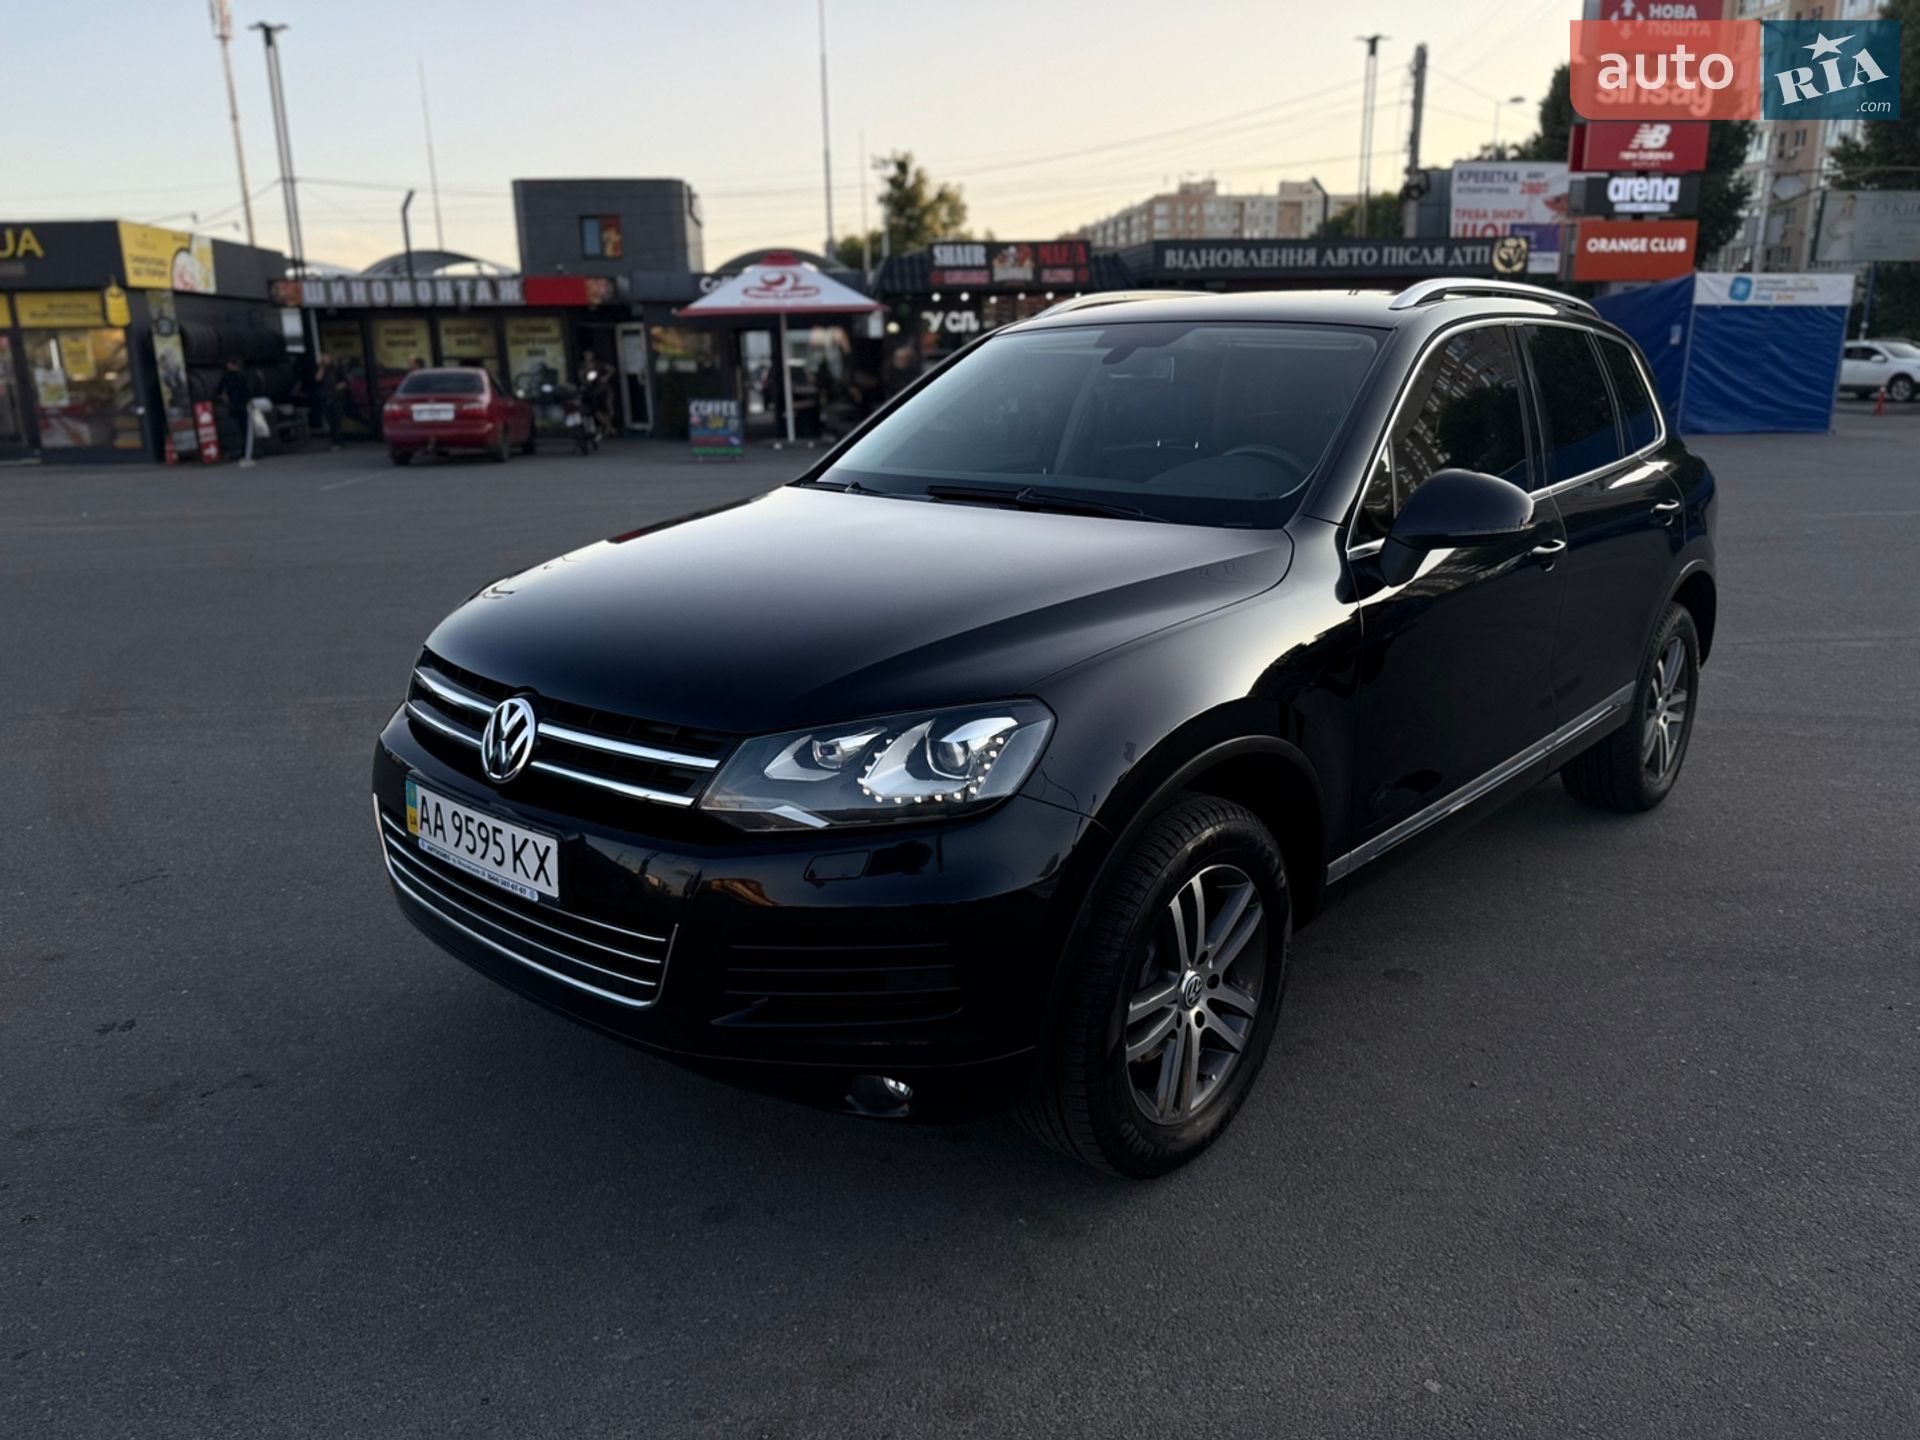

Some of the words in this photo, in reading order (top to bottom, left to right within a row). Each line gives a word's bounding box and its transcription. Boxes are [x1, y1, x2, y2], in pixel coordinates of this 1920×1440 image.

[1648, 4, 1697, 19] НОВА
[1647, 22, 1711, 37] ПОШТА
[1619, 151, 1638, 160] new
[1639, 150, 1674, 160] balance
[1457, 169, 1518, 184] КРЕВЕТКА
[1607, 177, 1680, 202] arena
[1586, 238, 1648, 252] ORANGE
[1650, 238, 1687, 252] CLUB
[1164, 248, 1316, 271] ВІДНОВЛЕННЯ
[1321, 247, 1377, 267] АВТО
[1382, 246, 1444, 266] ПІСЛЯ
[1448, 246, 1490, 268] ДТП
[304, 279, 522, 306] ШИНОМОНТАЖ
[420, 795, 447, 843] AA
[452, 810, 505, 867] 9595
[511, 833, 552, 888] KX
